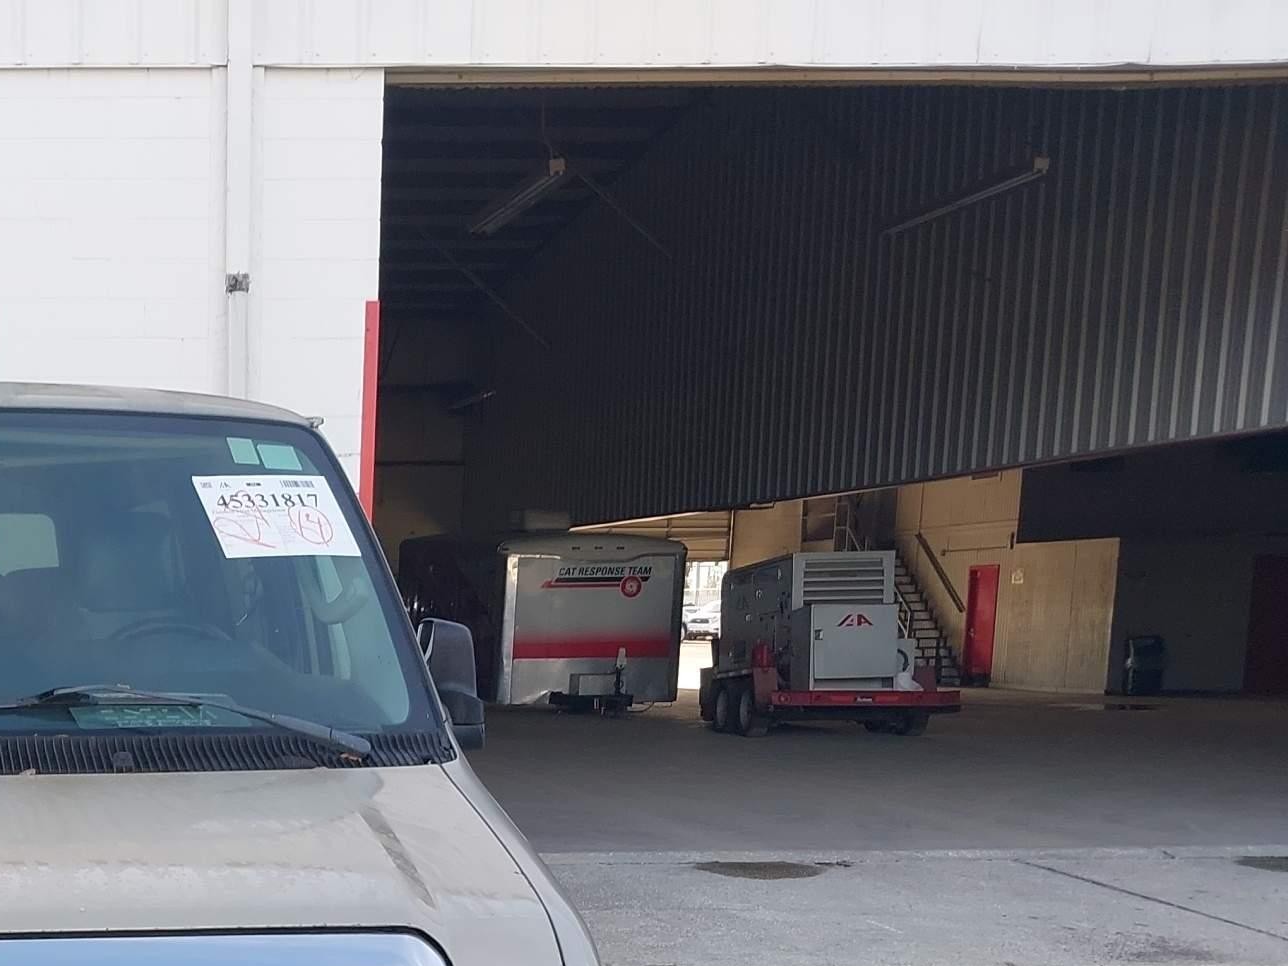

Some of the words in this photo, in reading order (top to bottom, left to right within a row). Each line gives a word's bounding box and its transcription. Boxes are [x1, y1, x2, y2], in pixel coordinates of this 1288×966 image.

[216, 493, 318, 508] 45331817
[558, 567, 578, 577] CAT
[578, 566, 626, 577] RESPONSE
[628, 566, 653, 577] TEAM
